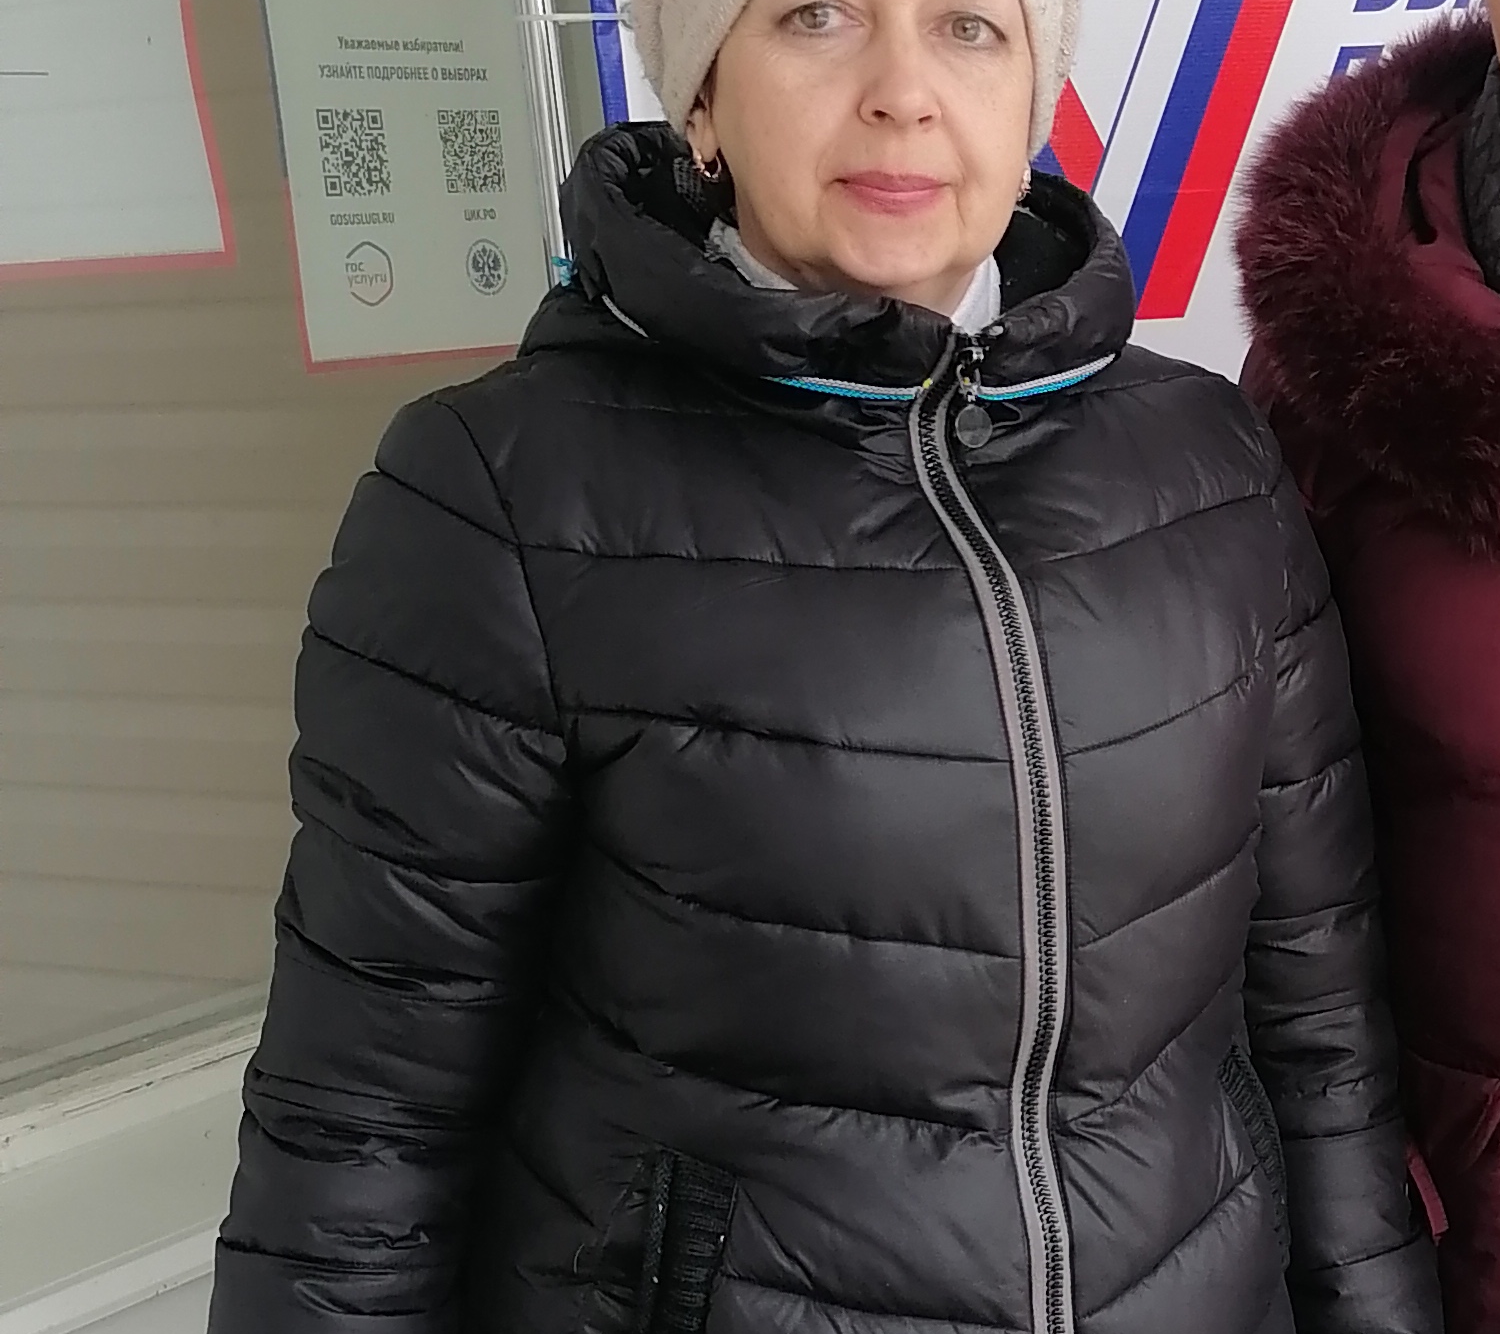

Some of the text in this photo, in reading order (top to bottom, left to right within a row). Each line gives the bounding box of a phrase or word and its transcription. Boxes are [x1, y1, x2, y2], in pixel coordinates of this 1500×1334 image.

[337, 36, 464, 54] Уважаемые избиратели!
[318, 62, 488, 81] УЗНАЙТЕ ПОДРОБНЕЕ О ВЫБОРАХ
